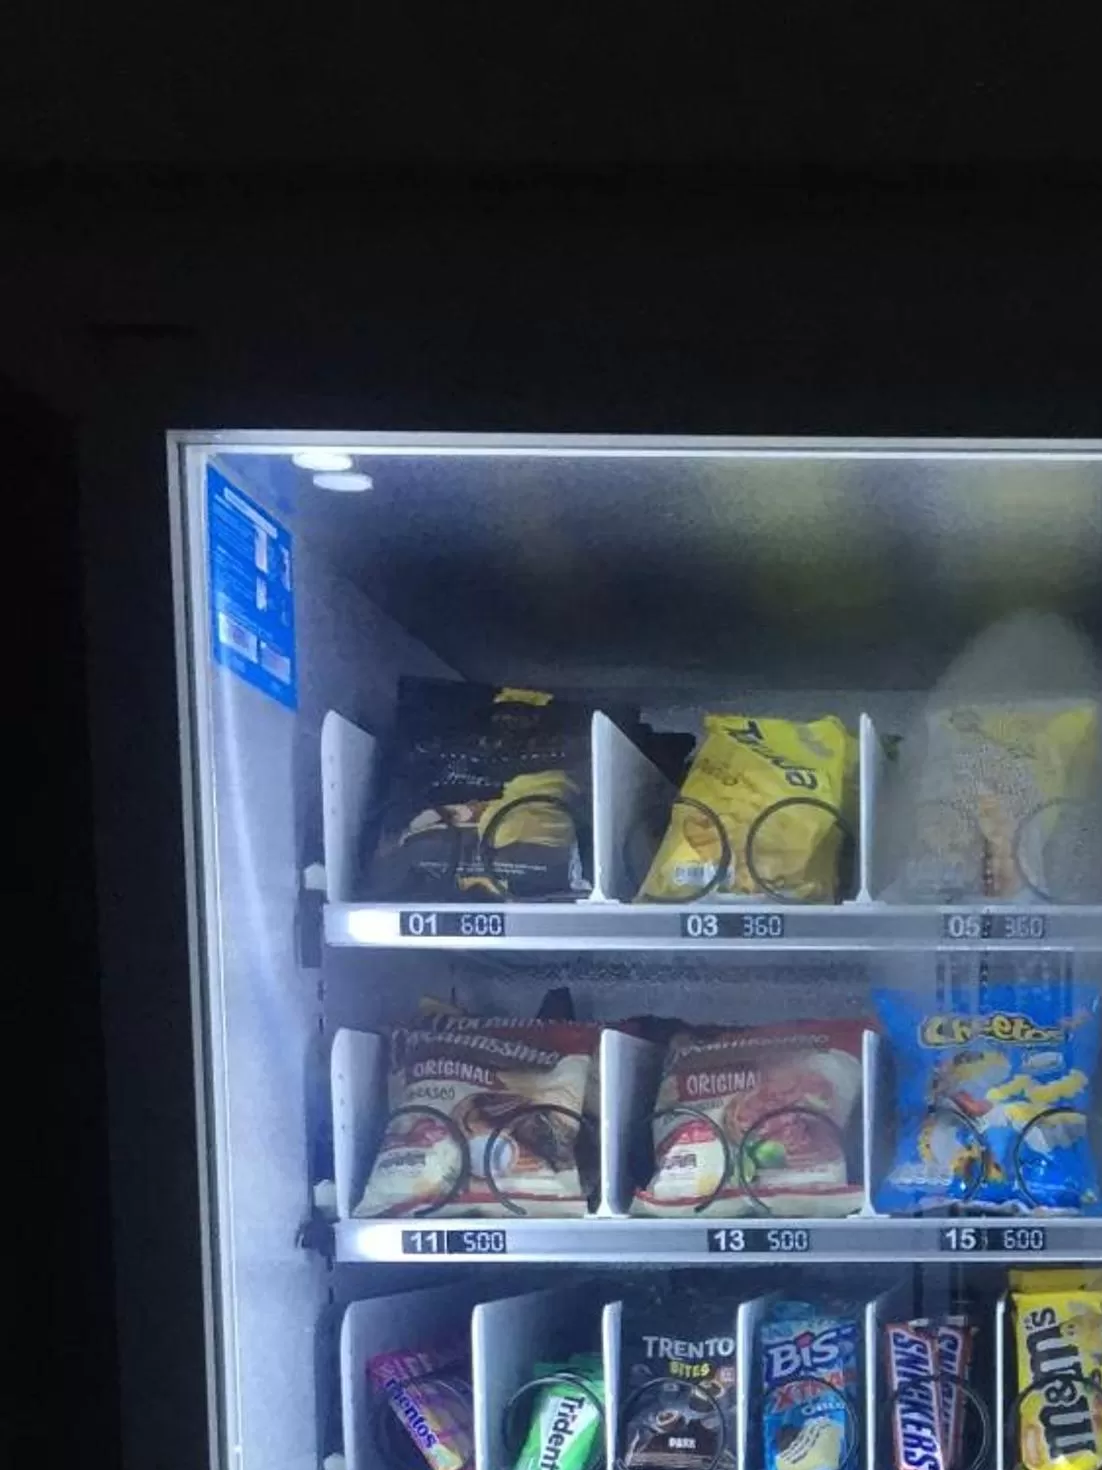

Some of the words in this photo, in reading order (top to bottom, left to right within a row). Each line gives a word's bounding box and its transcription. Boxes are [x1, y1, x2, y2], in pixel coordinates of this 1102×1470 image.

[409, 914, 437, 934] 01
[687, 915, 718, 936] 03
[948, 916, 981, 937] 05
[413, 1059, 494, 1085] ORIGINAL
[411, 1231, 438, 1252] 11
[714, 1230, 745, 1250] 13
[946, 1228, 976, 1249] 15
[642, 1335, 735, 1361] TRENTO
[670, 1361, 710, 1378] BITES
